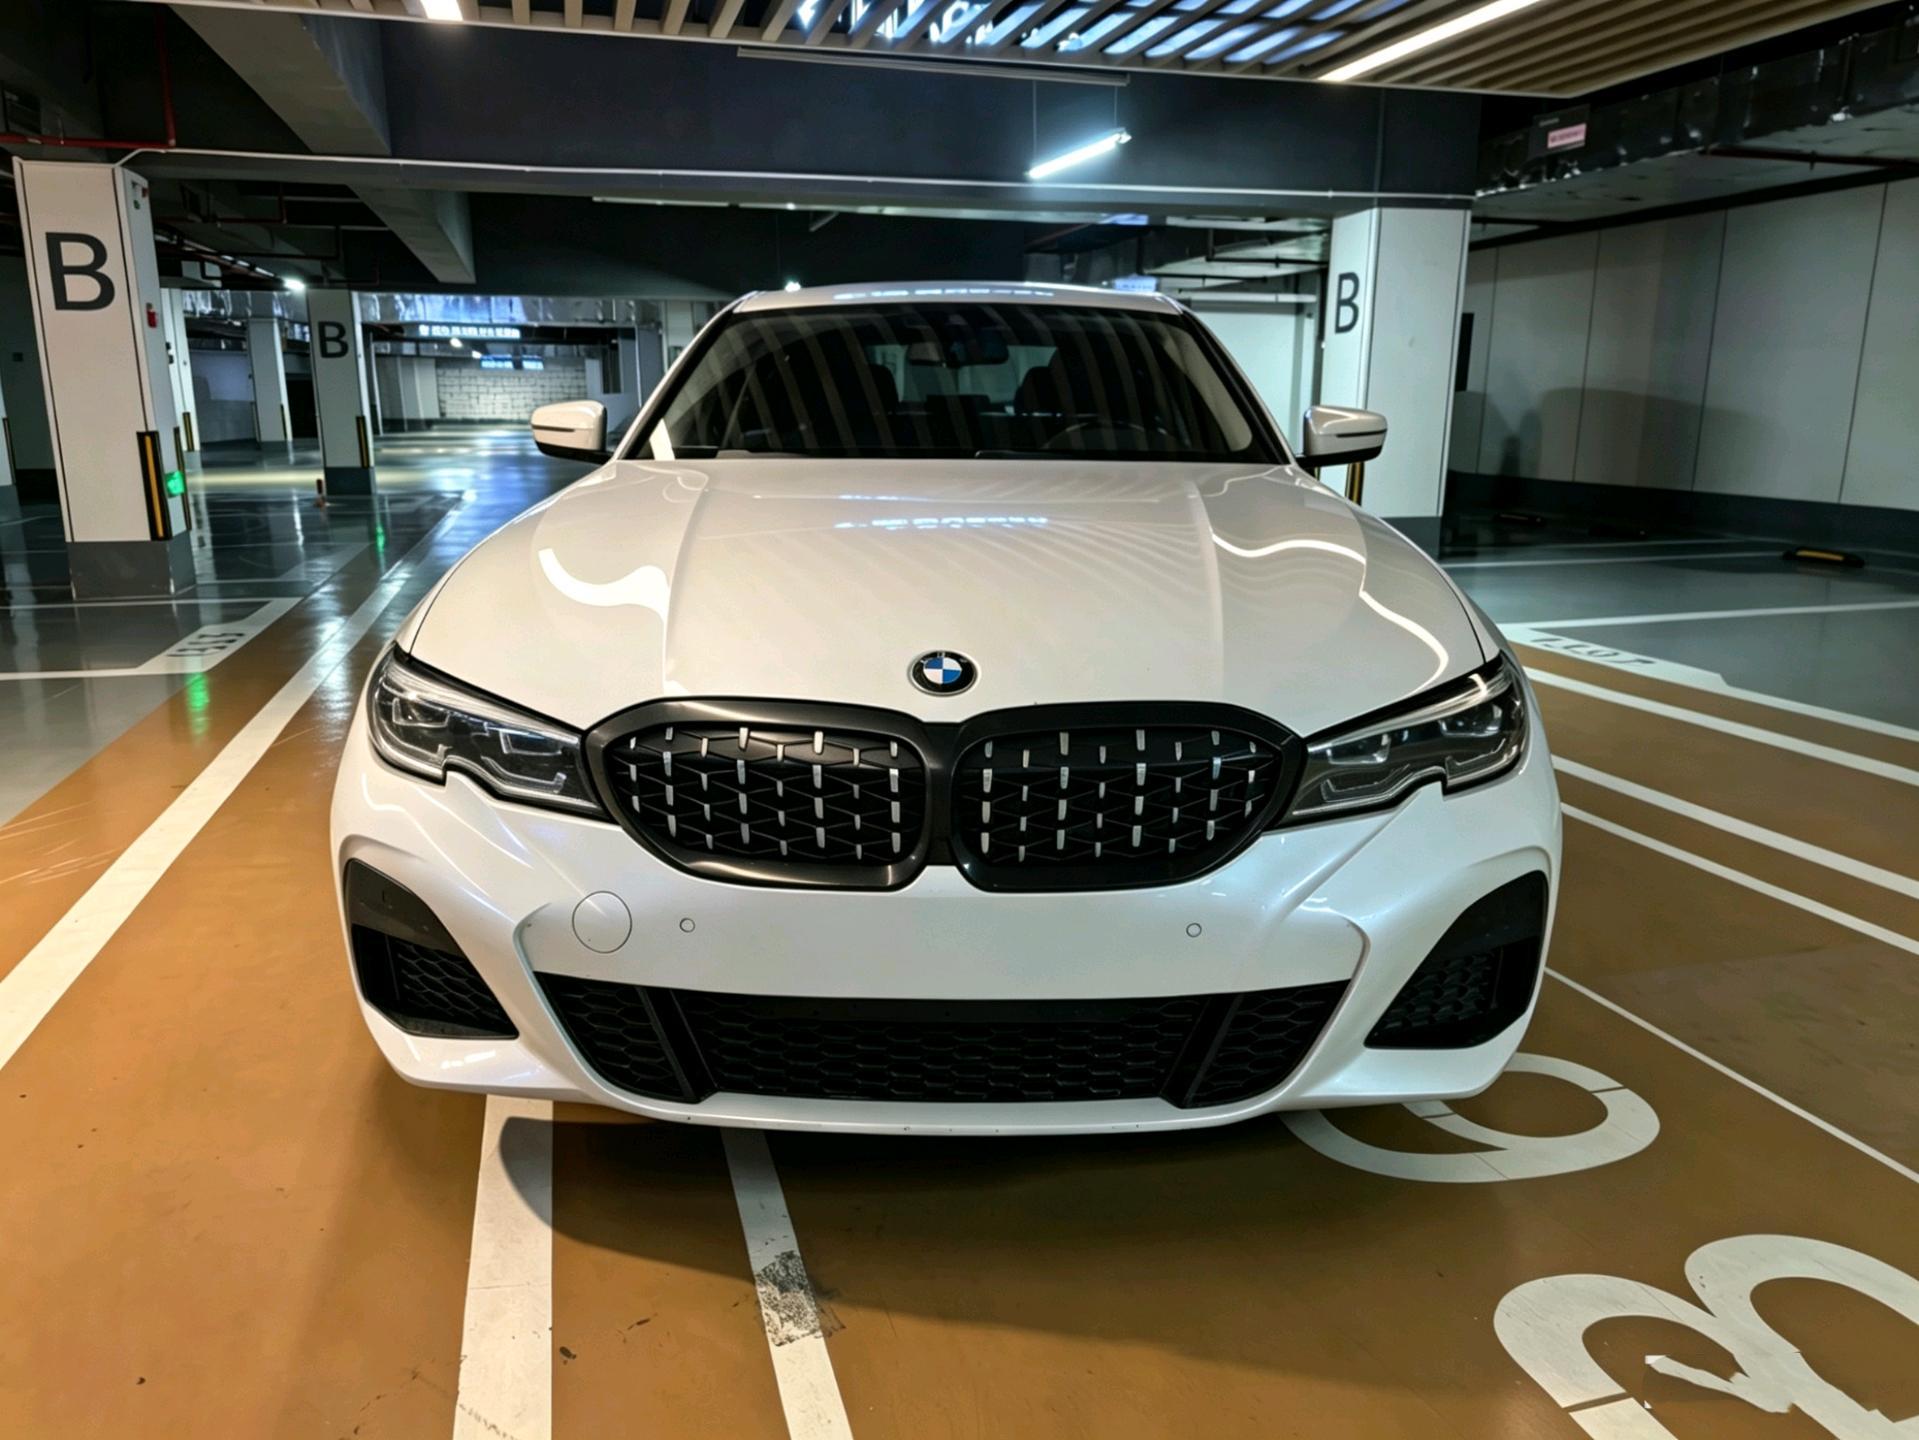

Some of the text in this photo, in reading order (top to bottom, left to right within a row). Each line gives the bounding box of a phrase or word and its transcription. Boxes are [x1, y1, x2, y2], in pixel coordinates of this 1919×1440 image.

[45, 232, 115, 312] B
[1335, 272, 1359, 335] B
[318, 321, 349, 359] B
